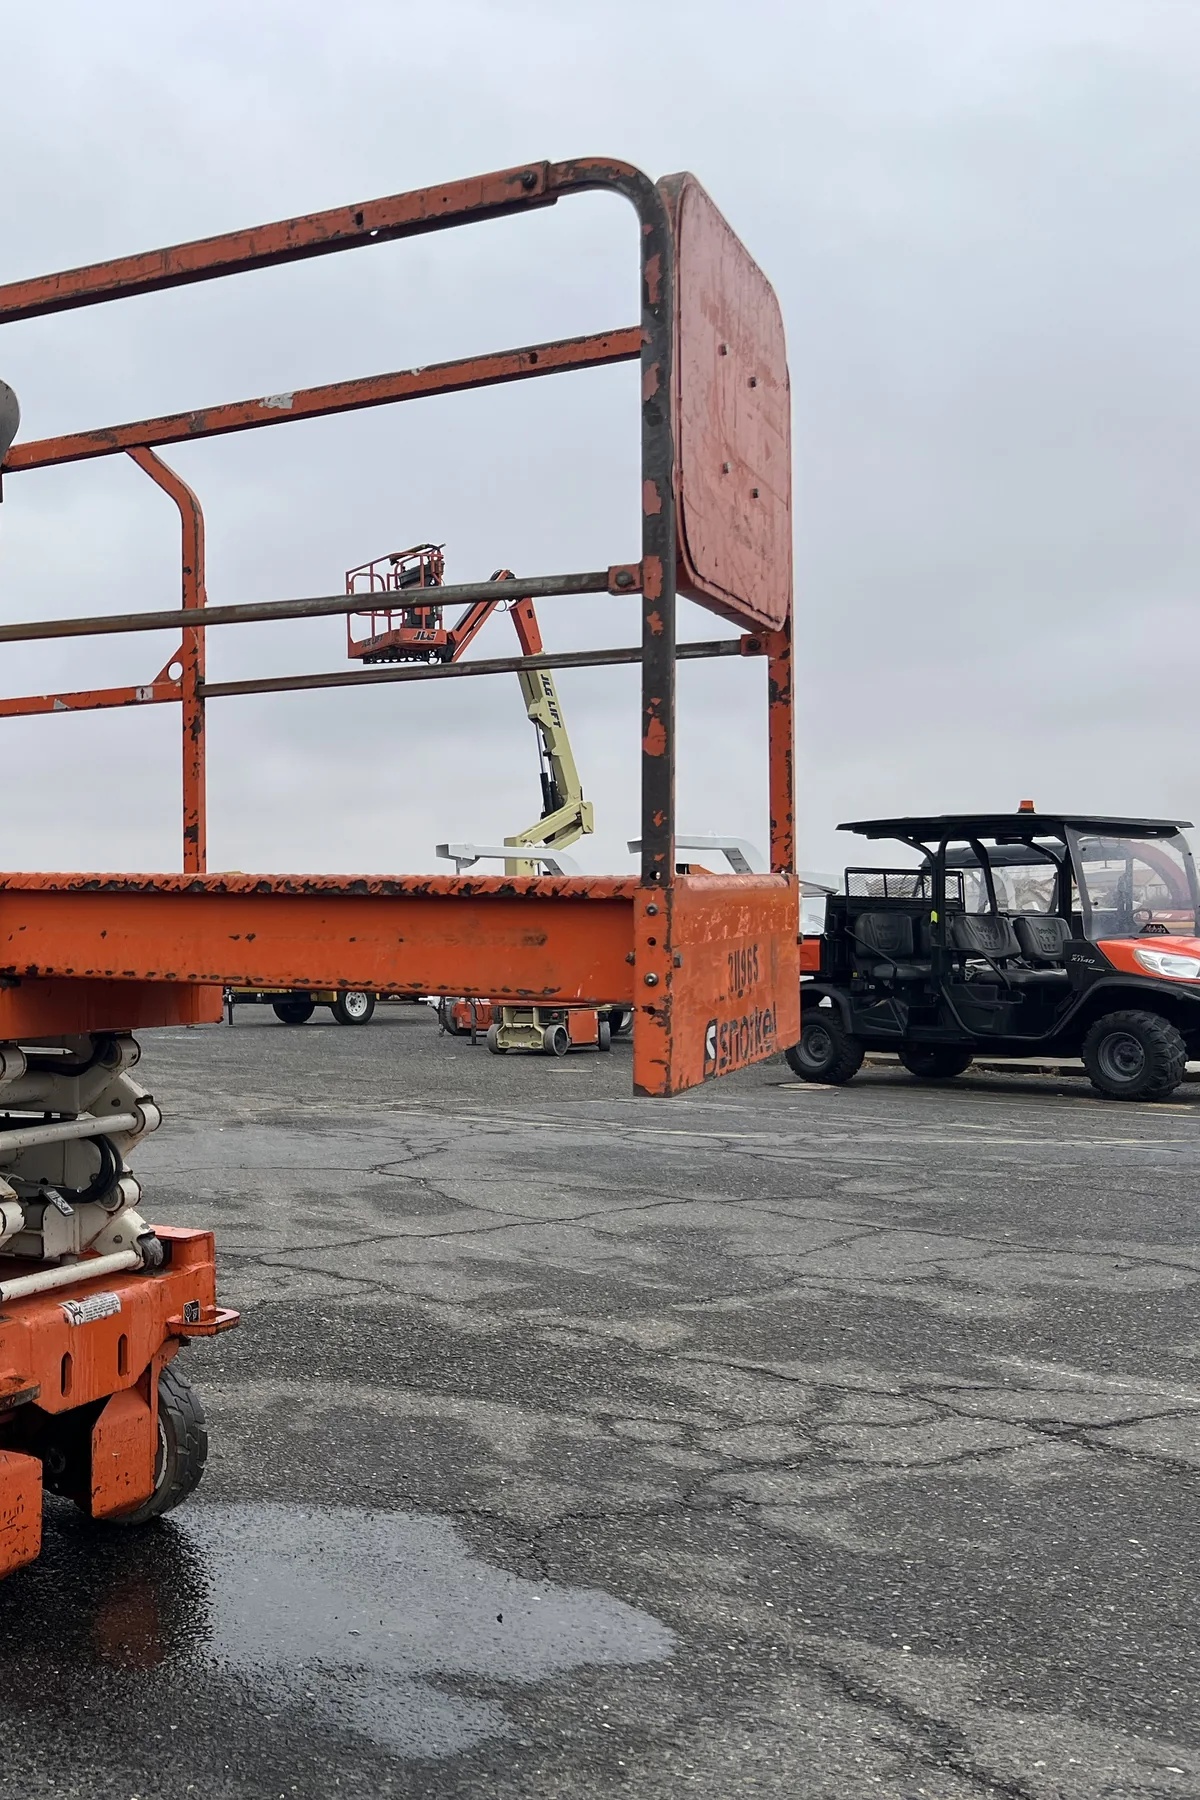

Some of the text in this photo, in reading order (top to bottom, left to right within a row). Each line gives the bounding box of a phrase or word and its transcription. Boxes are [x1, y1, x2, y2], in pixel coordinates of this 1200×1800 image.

[413, 631, 437, 641] JLG
[540, 673, 562, 728] JLG LIFT
